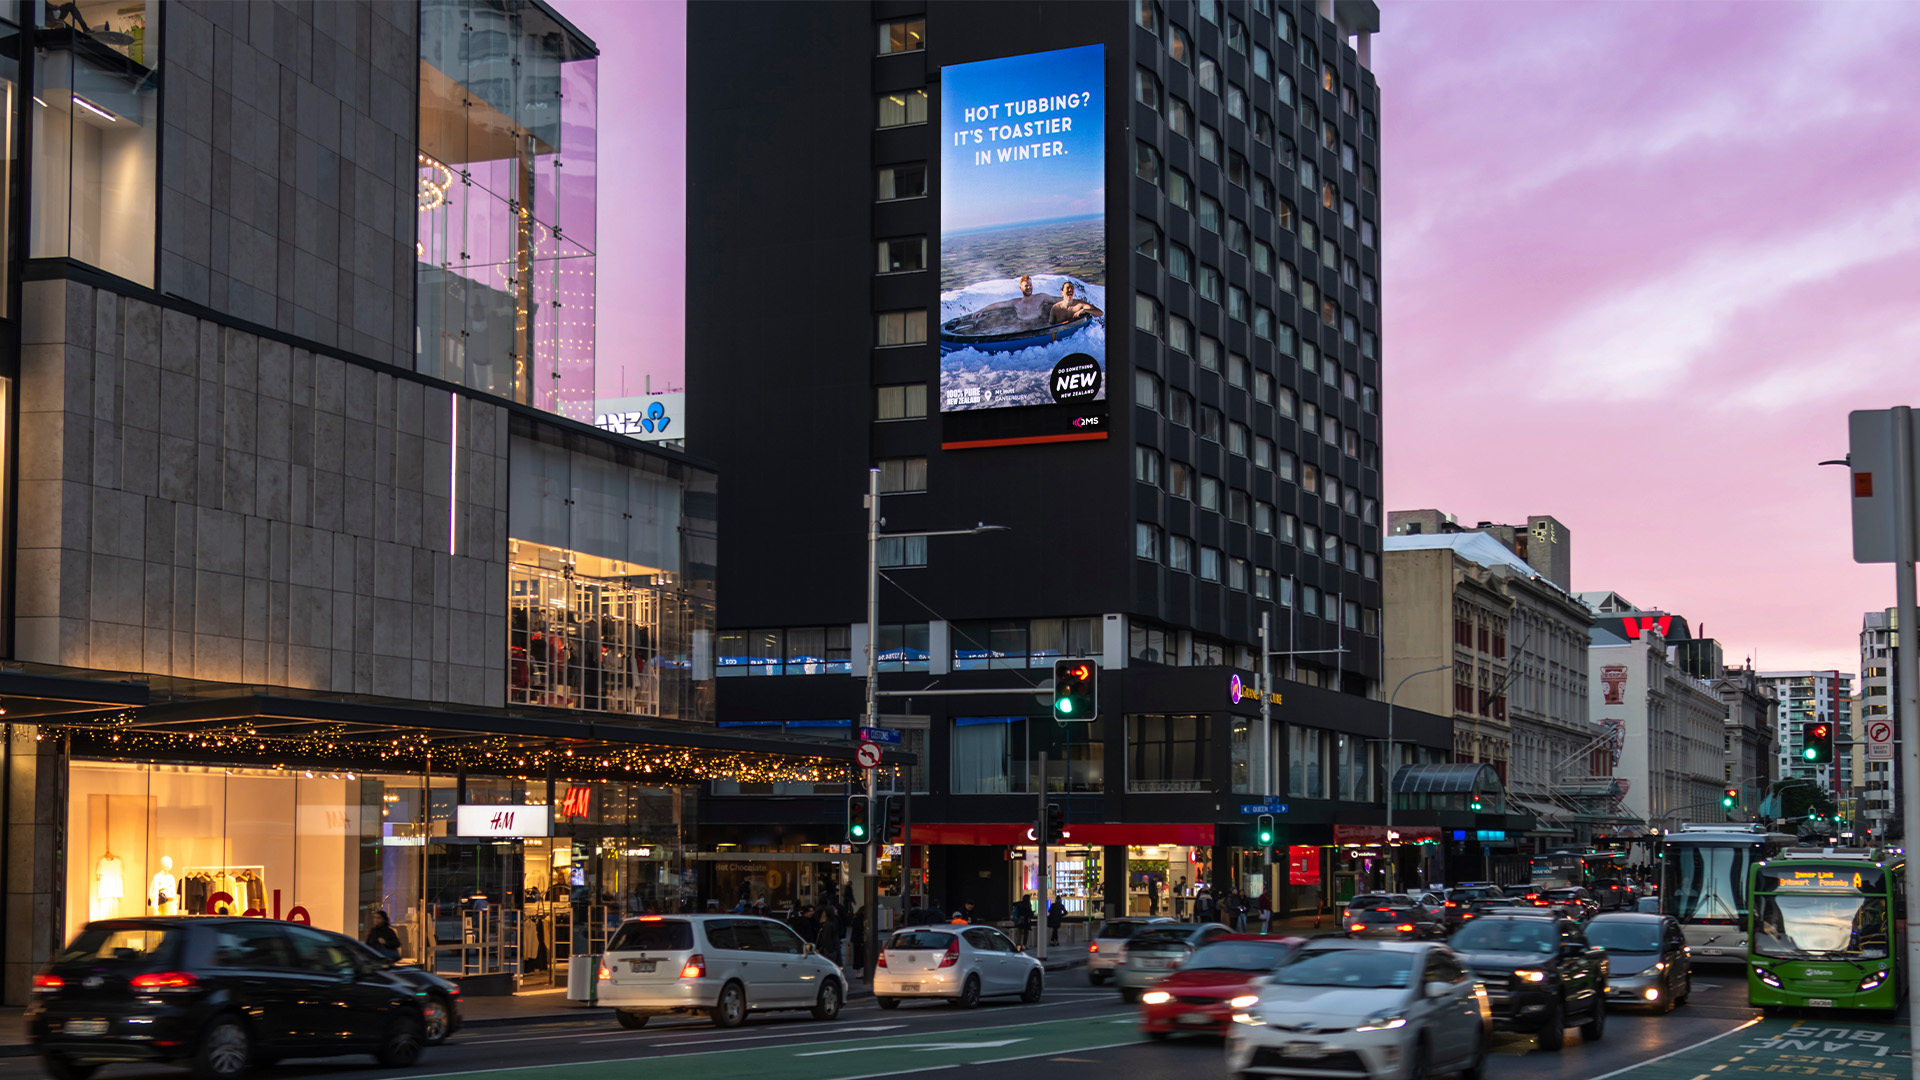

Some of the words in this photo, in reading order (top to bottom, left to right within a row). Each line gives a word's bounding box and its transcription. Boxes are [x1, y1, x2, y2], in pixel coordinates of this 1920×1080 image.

[964, 104, 999, 123] HOT
[1004, 92, 1090, 117] TUBBING?
[954, 129, 984, 146] IT'S
[988, 117, 1072, 141] TOASTIER
[975, 150, 991, 166] IN
[997, 141, 1068, 163] WINTER.
[1066, 364, 1093, 372] SOMETHING
[1056, 371, 1097, 392] NEW
[947, 389, 964, 399] 100%
[964, 387, 980, 396] PURE
[947, 397, 958, 405] NEW
[958, 396, 980, 405] ZEALAND
[1072, 389, 1095, 397] ZEALAND
[595, 411, 642, 434] ANZ
[562, 787, 591, 819] H&M
[490, 811, 514, 830] H&M
[1853, 872, 1862, 888] A
[1782, 1027, 1886, 1042] BUS
[1738, 1038, 1890, 1056] LANE
